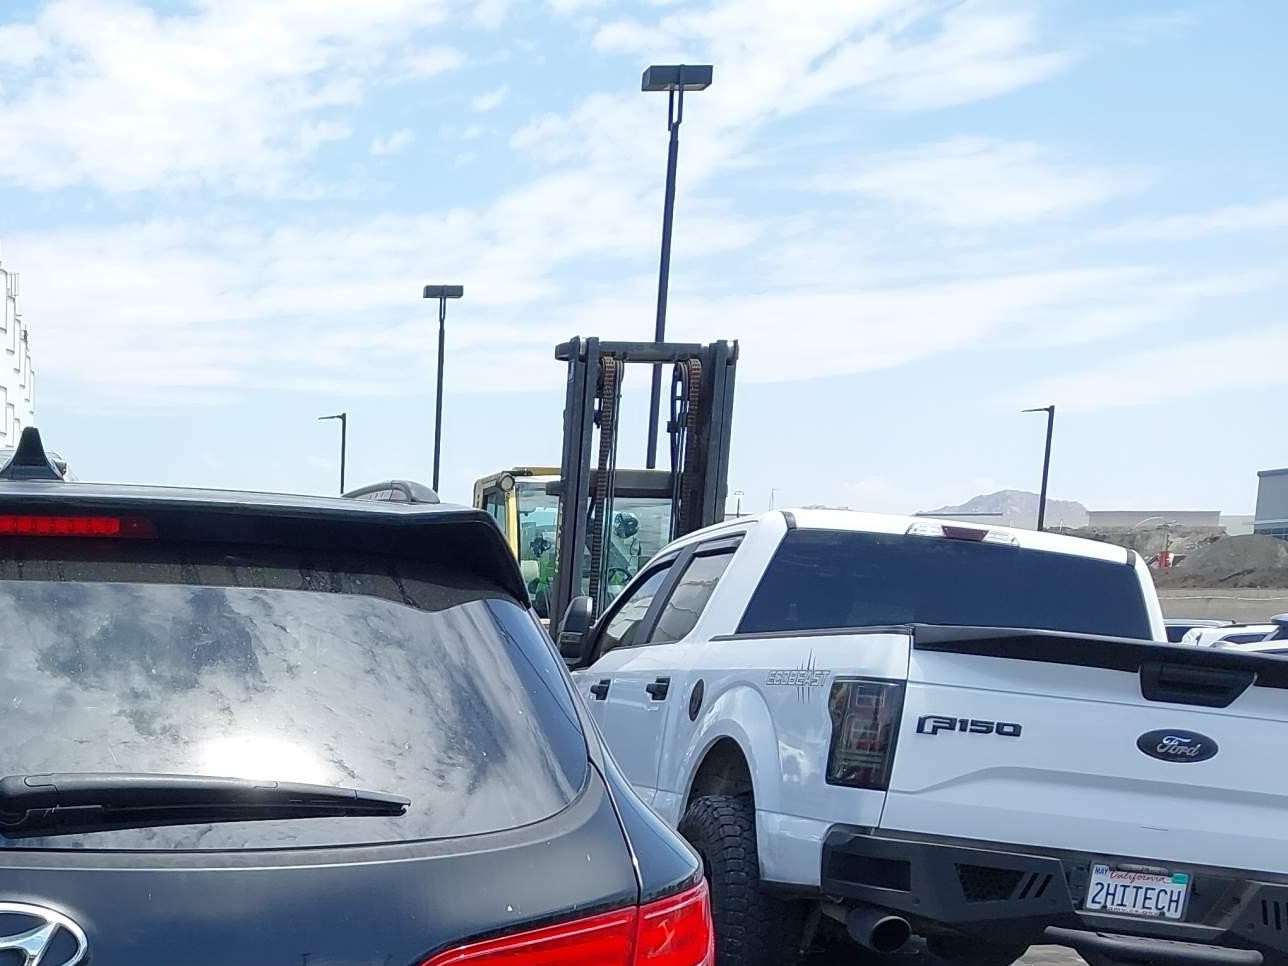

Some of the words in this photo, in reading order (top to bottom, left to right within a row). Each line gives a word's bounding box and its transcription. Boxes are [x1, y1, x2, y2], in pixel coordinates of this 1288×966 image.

[766, 669, 832, 687] ECOBEAST
[1156, 735, 1202, 757] Ford
[1110, 869, 1169, 884] California
[1091, 881, 1182, 914] 2HITECH
